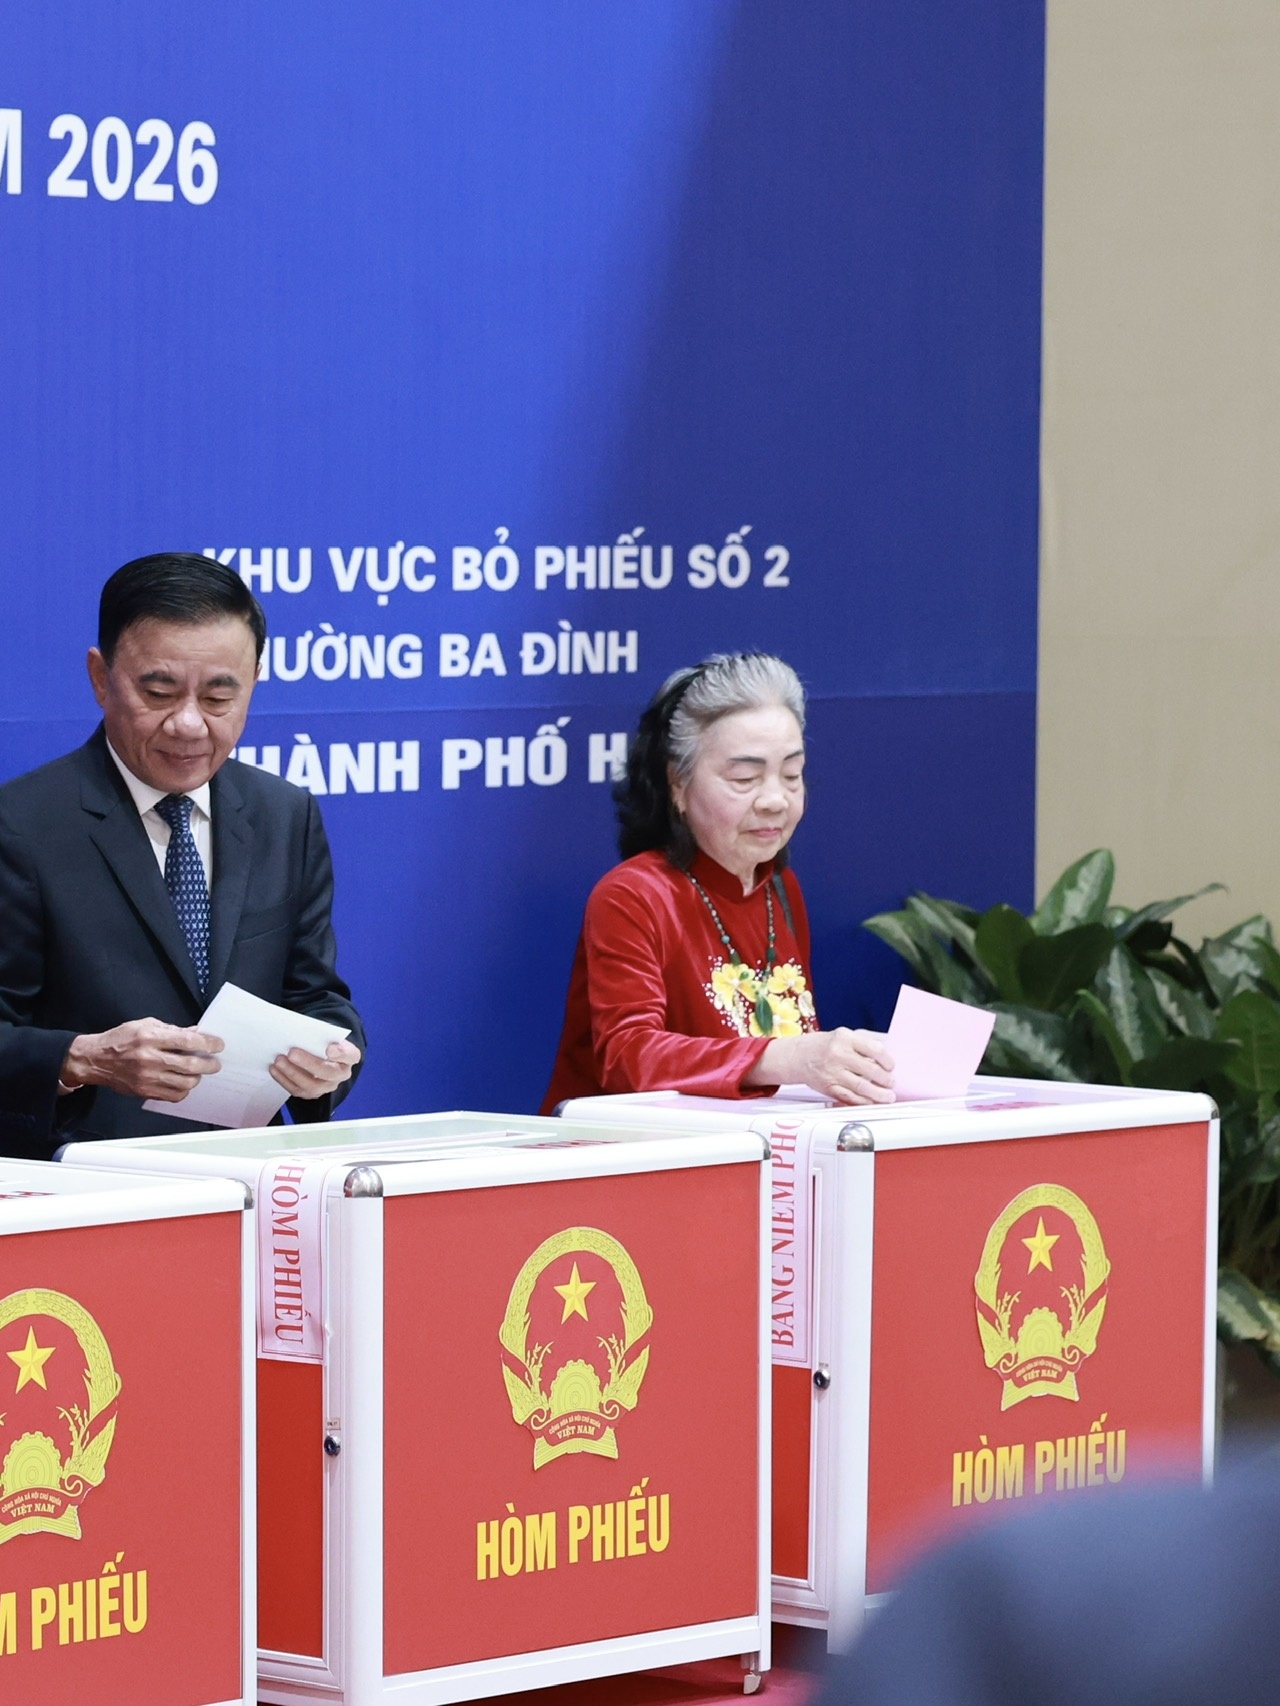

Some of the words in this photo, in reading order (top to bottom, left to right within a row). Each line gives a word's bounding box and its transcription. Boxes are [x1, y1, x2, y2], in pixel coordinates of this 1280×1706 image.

[47, 113, 218, 205] 2026
[328, 540, 436, 606] VỰC
[452, 526, 520, 591] BỎ
[535, 526, 673, 590] PHIẾU
[688, 525, 751, 588] SỐ
[764, 545, 789, 587] 2
[258, 622, 423, 682] ƯỜNG
[439, 633, 507, 678] BA
[519, 620, 638, 676] ĐÌNH
[228, 732, 421, 795] HÀNH
[442, 716, 571, 790] PHỐ
[272, 1165, 308, 1239] HÒM
[273, 1247, 312, 1345] PHIẾU
[577, 1425, 595, 1435] NAM
[952, 1434, 1025, 1508] HÒM
[1034, 1412, 1126, 1495] PHIẾU
[10, 1503, 32, 1517] VIỆT
[34, 1503, 55, 1513] NAM
[476, 1502, 557, 1581] HÒM
[569, 1476, 670, 1564] PHIẾU
[30, 1551, 148, 1651] PHIẾU
